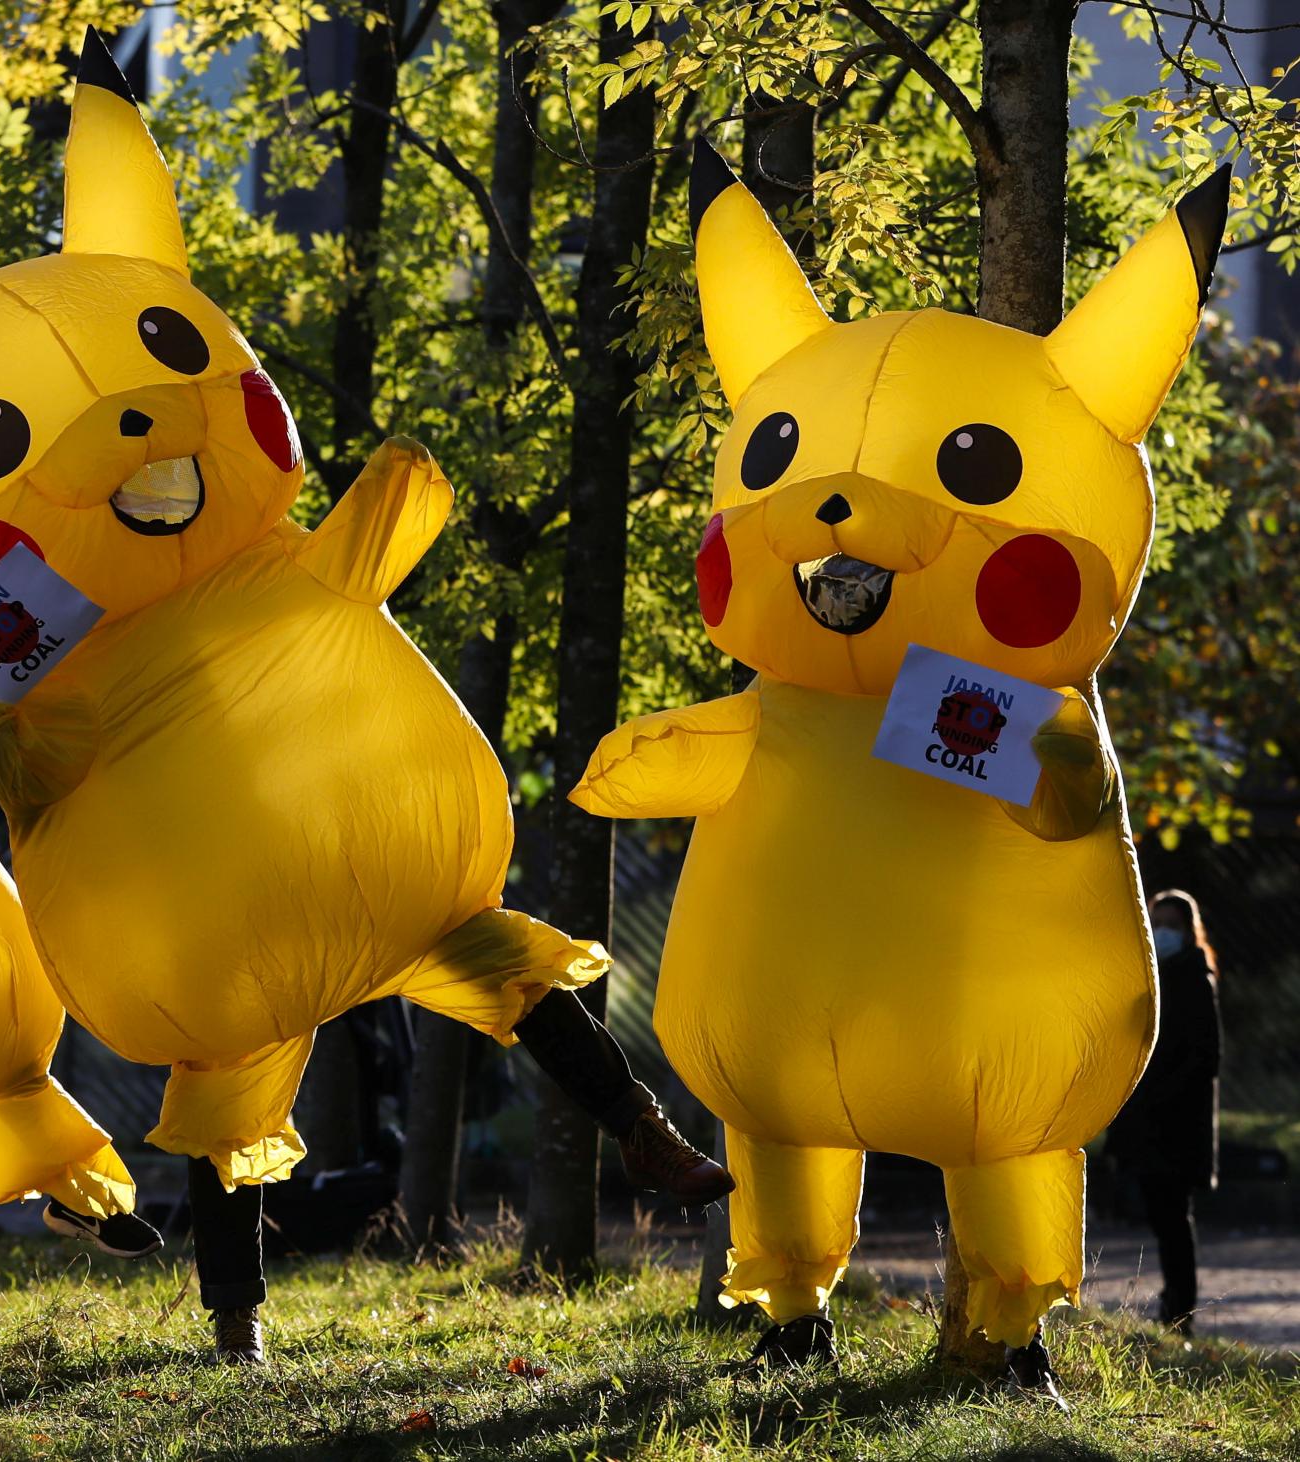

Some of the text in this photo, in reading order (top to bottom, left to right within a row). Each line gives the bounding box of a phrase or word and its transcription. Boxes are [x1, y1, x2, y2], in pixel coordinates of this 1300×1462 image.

[10, 634, 65, 683] COAL
[942, 675, 1014, 710] JAPAN
[937, 696, 1007, 733] STOP
[931, 723, 998, 754] FUNDING
[925, 743, 988, 780] COAL
